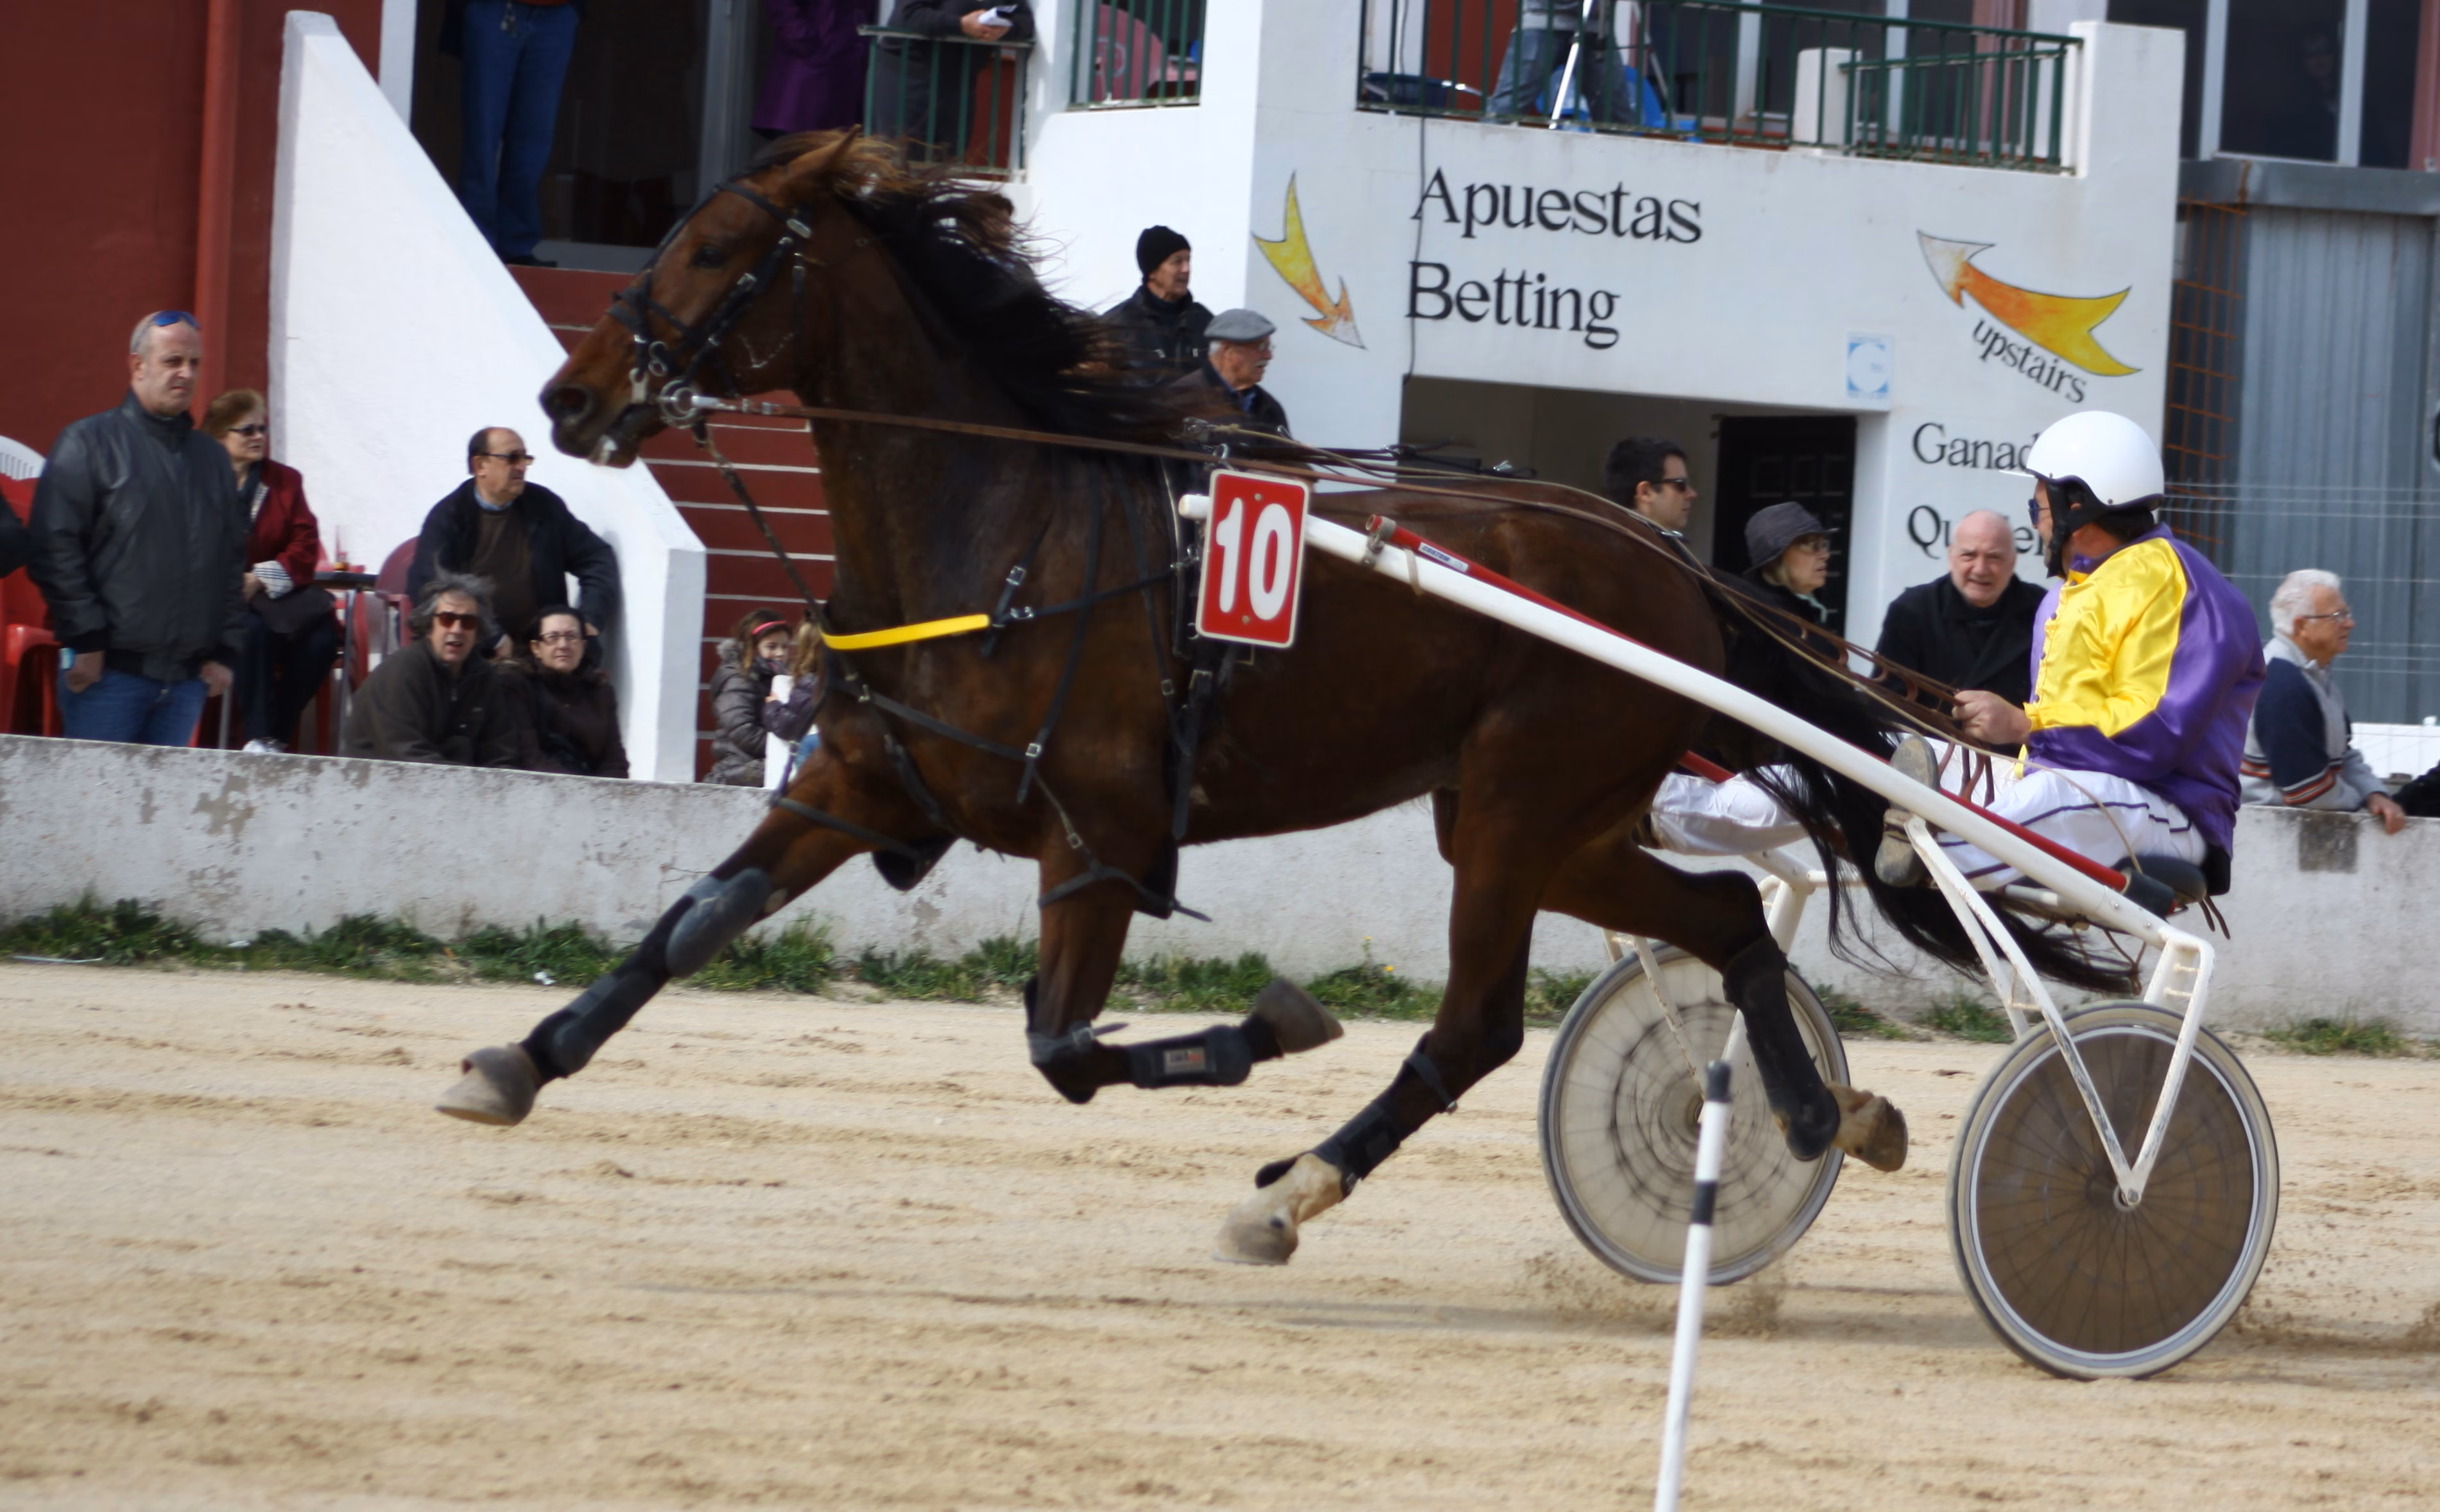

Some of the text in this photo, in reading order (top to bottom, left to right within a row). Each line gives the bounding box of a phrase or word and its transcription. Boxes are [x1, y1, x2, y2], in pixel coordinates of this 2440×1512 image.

[1411, 166, 1702, 244] Apuestas
[1405, 261, 1621, 350] Betting
[1972, 318, 2088, 404] upstairs
[1912, 422, 2041, 470] Ganad
[1216, 497, 1293, 621] 10
